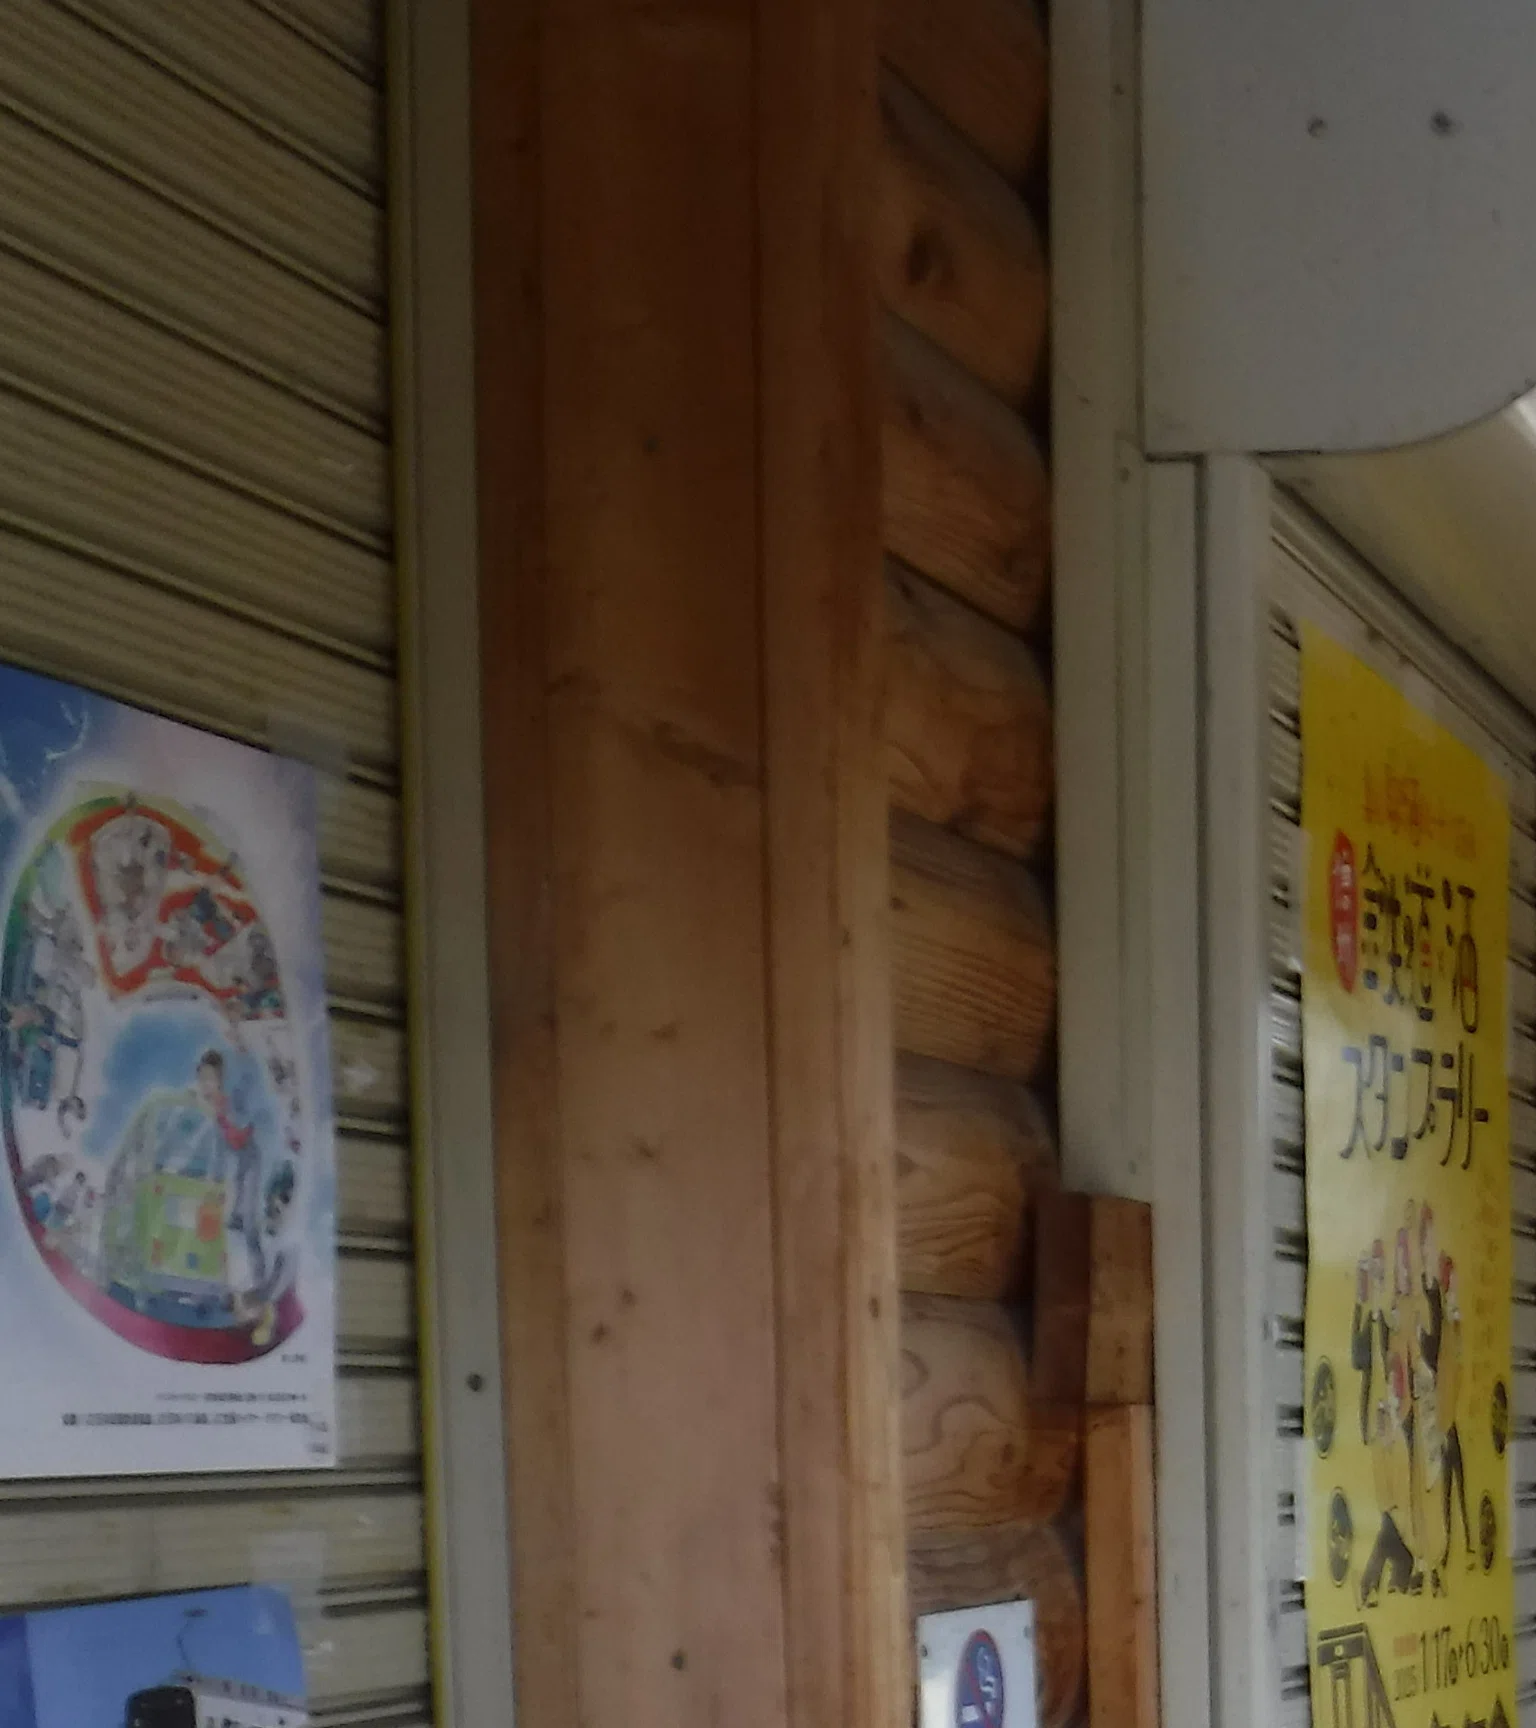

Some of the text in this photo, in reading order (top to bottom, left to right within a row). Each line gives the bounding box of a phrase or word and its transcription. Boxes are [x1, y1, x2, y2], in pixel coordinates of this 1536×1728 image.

[1339, 1033, 1489, 1172] スタンプラリー
